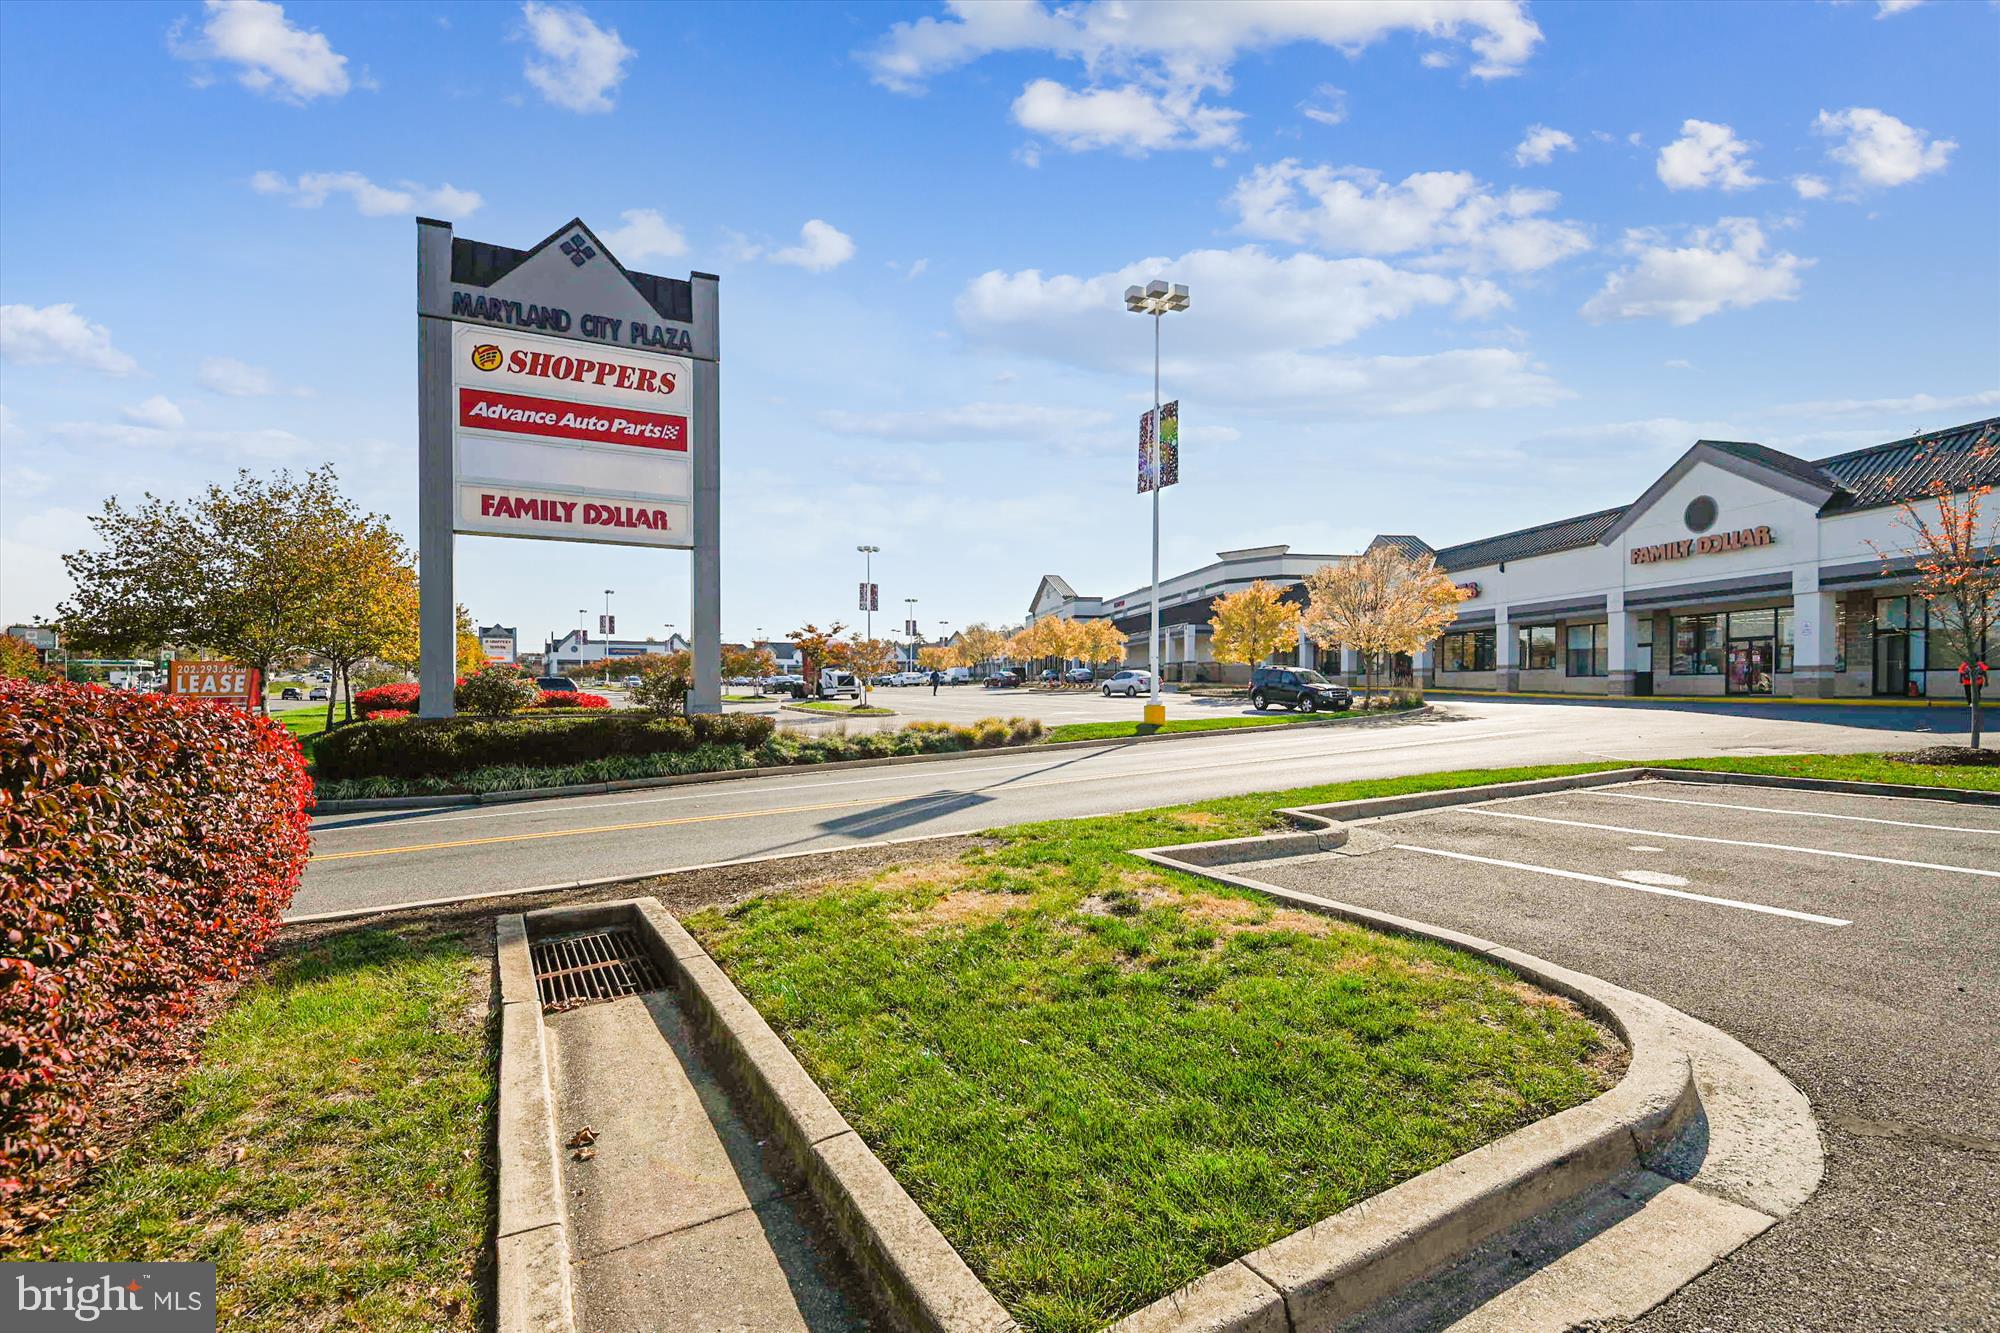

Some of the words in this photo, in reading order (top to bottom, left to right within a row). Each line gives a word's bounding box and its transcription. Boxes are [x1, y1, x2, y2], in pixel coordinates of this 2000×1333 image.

[452, 291, 571, 333] MARYLAND
[580, 314, 622, 341] CITY
[631, 321, 693, 352] PLAZA
[506, 350, 677, 395] SHOPPERS
[469, 401, 557, 425] Advance
[557, 412, 610, 432] Auto
[610, 418, 662, 438] Parts
[481, 494, 578, 523] FAMILY
[583, 503, 668, 531] DOLLAR
[1630, 538, 1693, 565] FAMILY
[1696, 525, 1772, 555] DOLLAR
[176, 674, 247, 693] LEASE
